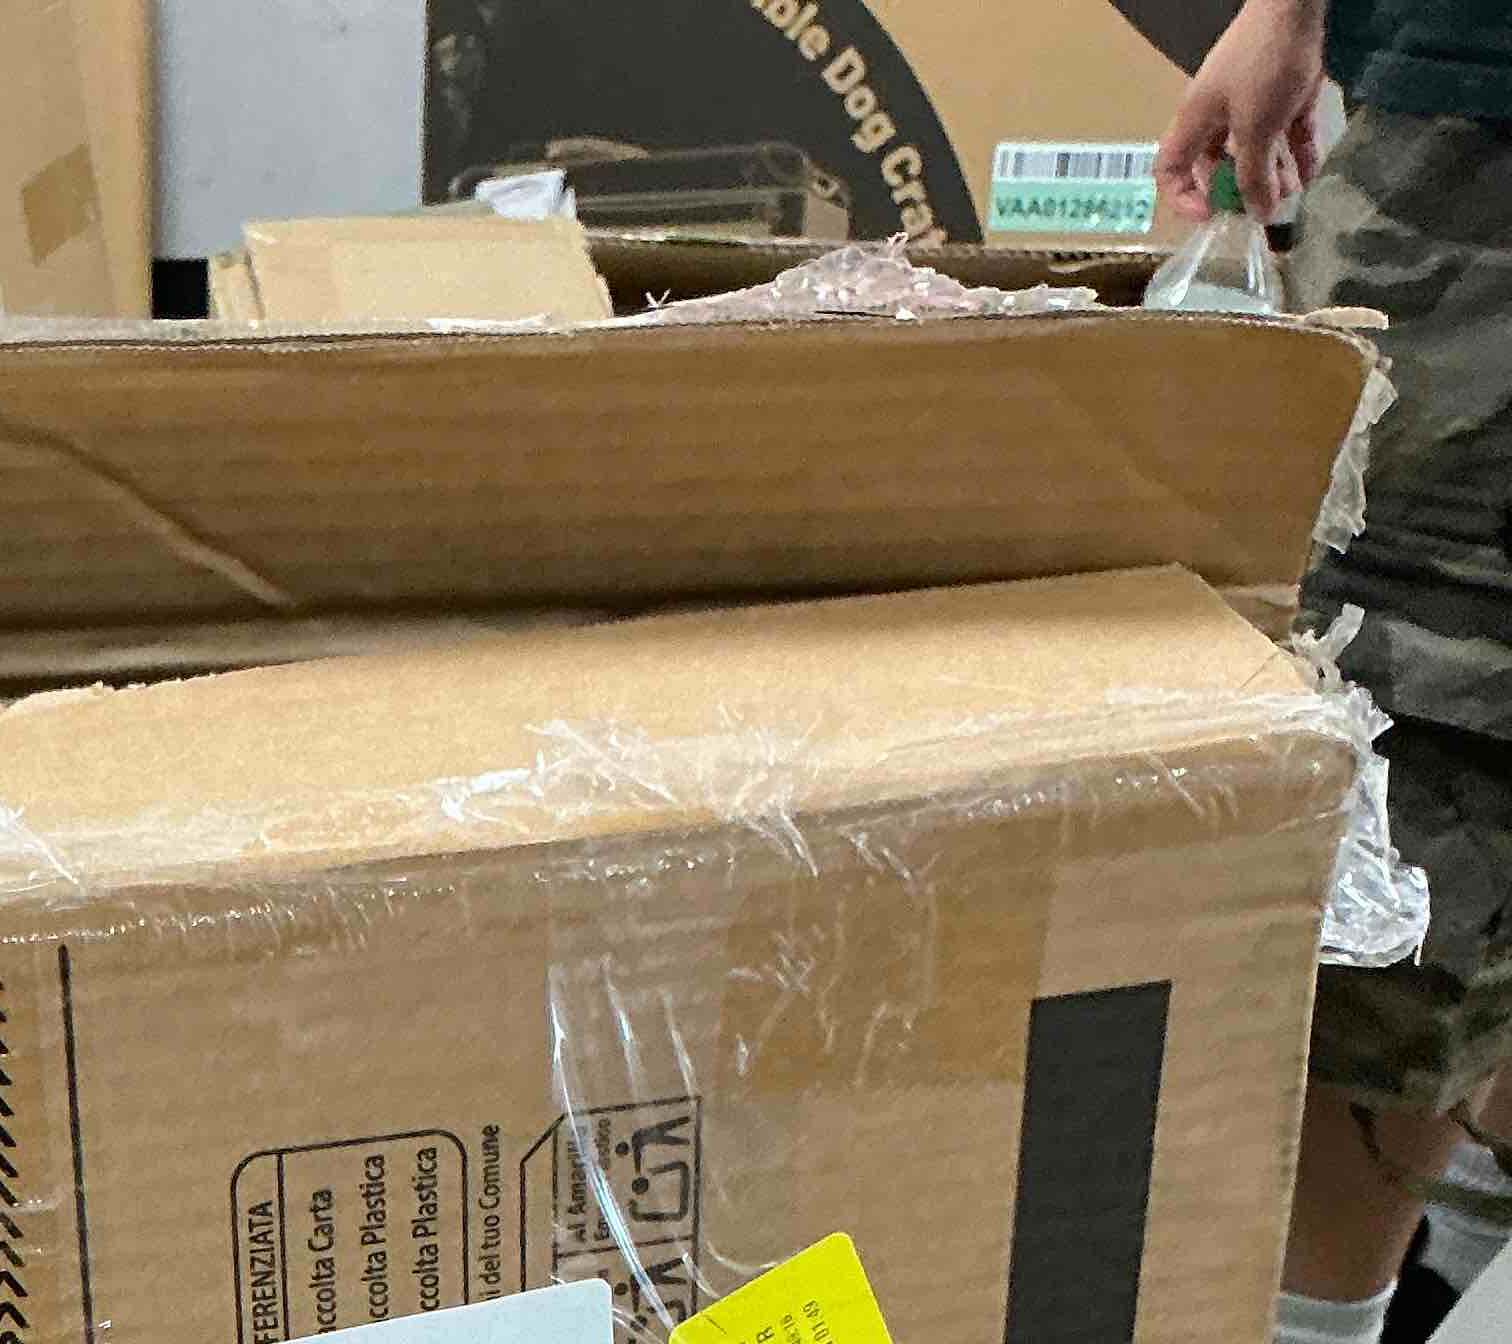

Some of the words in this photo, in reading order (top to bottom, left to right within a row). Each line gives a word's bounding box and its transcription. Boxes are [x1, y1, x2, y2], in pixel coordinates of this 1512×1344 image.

[746, 0, 832, 62] ble
[821, 45, 897, 154] Dog
[881, 143, 948, 249] Cra
[358, 1154, 388, 1238] Plastica
[410, 1146, 439, 1230] Plastica
[477, 1123, 502, 1212] Comune
[309, 1188, 334, 1237] Carta
[479, 1220, 501, 1257] tuo
[360, 1241, 389, 1322] ccolta
[479, 1260, 501, 1287] del
[754, 1326, 775, 1343] R
